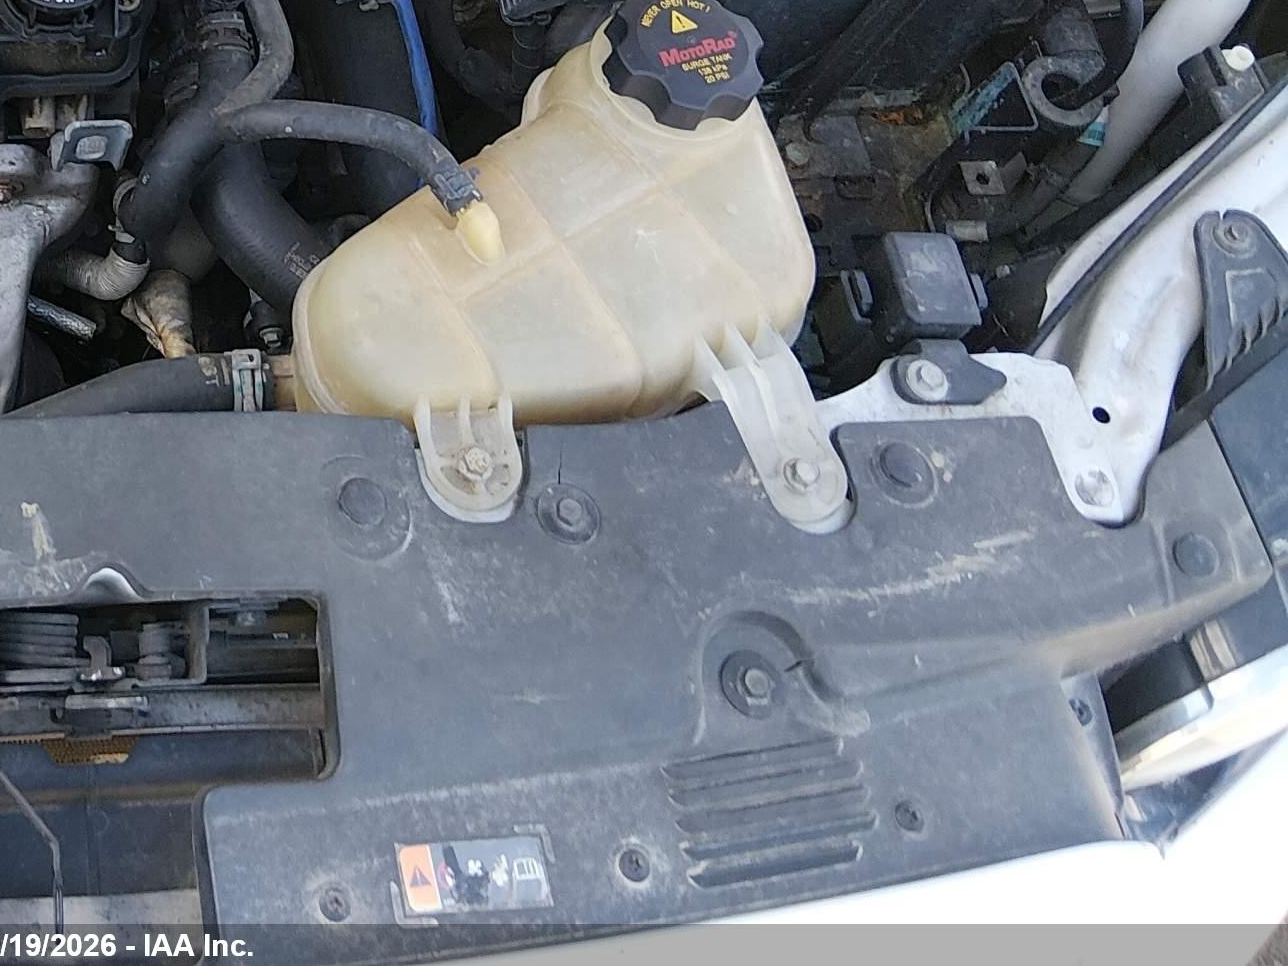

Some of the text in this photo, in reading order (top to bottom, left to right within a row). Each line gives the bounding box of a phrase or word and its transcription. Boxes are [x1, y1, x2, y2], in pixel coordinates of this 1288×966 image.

[641, 5, 661, 27] NEVER
[681, 52, 733, 72] SURGE TANK
[713, 63, 728, 73] kPa
[704, 72, 731, 84] 20 PSI
